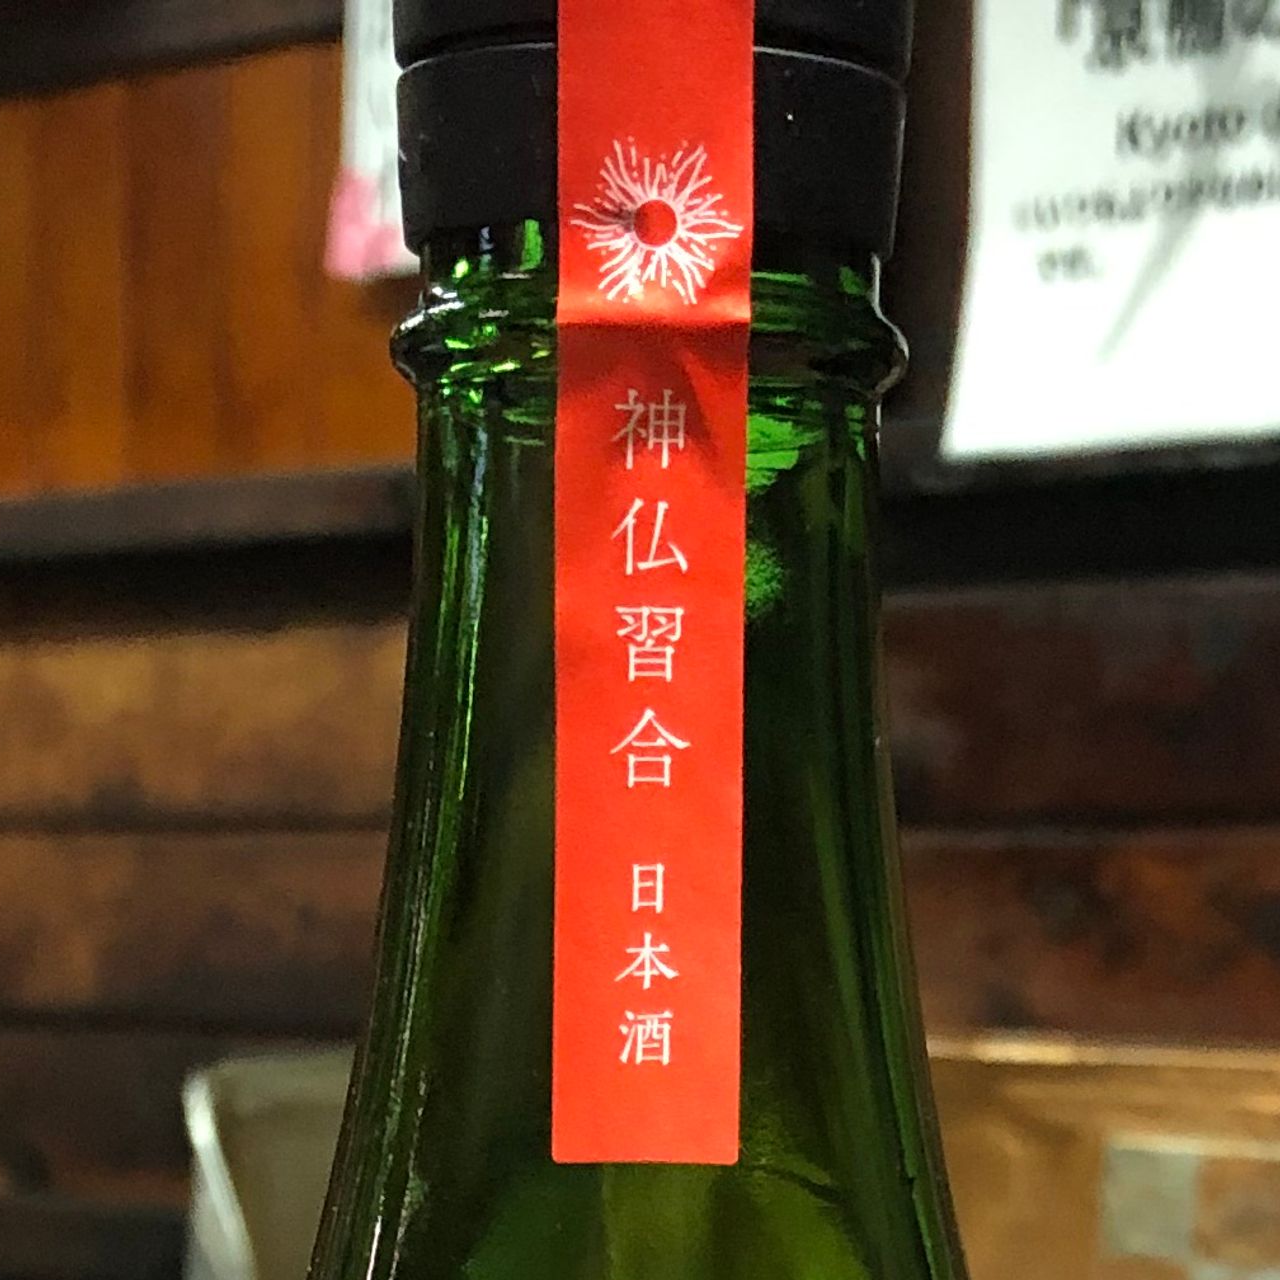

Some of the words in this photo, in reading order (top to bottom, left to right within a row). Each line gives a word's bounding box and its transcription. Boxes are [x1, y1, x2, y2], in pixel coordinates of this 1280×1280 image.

[1116, 105, 1247, 162] Kyoto
[609, 388, 692, 790] 神仏習合
[614, 861, 681, 1067] 日本酒
